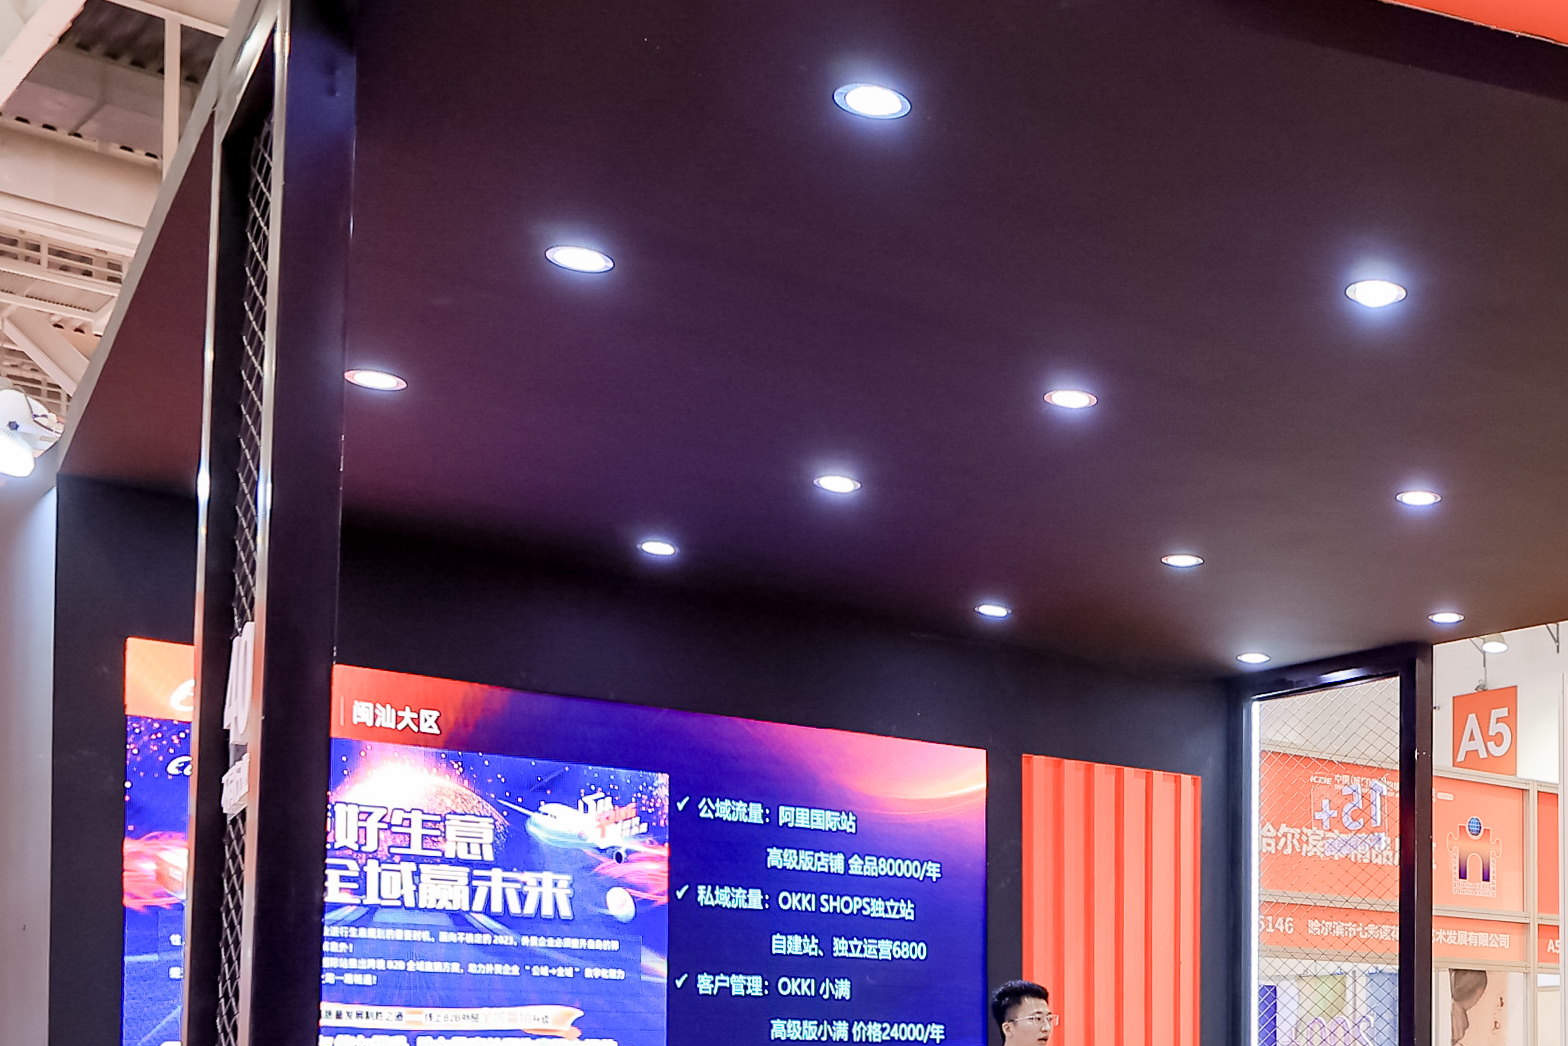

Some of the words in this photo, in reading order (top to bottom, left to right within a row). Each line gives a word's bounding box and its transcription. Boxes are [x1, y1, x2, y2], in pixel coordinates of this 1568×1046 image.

[352, 700, 441, 736] 闽汕大区
[1456, 706, 1513, 763] A5
[326, 801, 495, 862] 好生意
[766, 847, 845, 875] 高级版店铺
[847, 851, 942, 882] 金品80000/年
[324, 857, 574, 920] 全域赢未来
[770, 933, 927, 961] 自建站、独立运营6800
[819, 977, 852, 1000] 小满
[770, 1019, 849, 1043] 高级版小满
[852, 1021, 945, 1045] 价格24000/年
